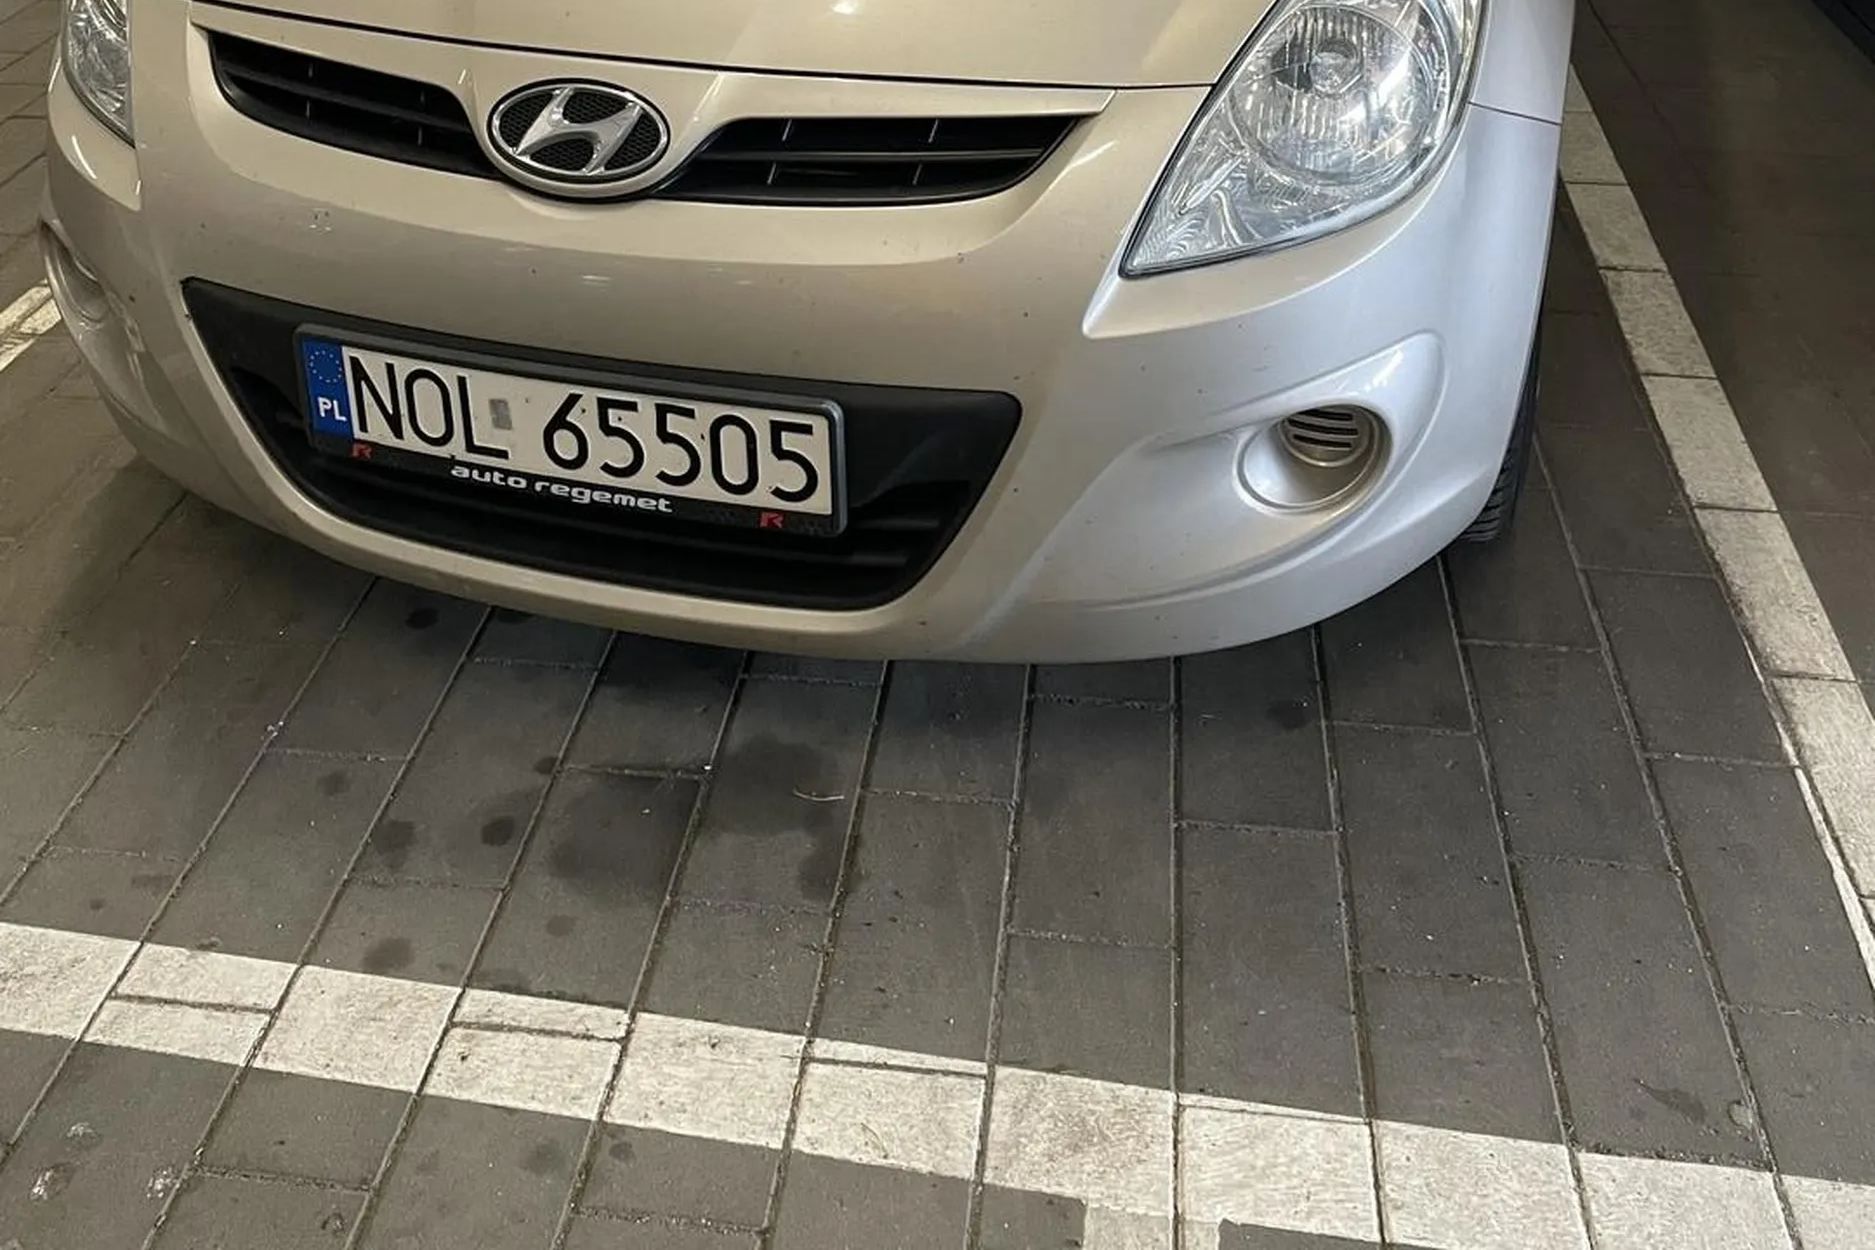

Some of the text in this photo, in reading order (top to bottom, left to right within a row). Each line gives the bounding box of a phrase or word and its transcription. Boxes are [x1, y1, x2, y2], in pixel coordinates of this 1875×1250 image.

[317, 396, 347, 422] PL
[348, 355, 818, 503] NOL 65505
[450, 465, 674, 513] auto regemet
